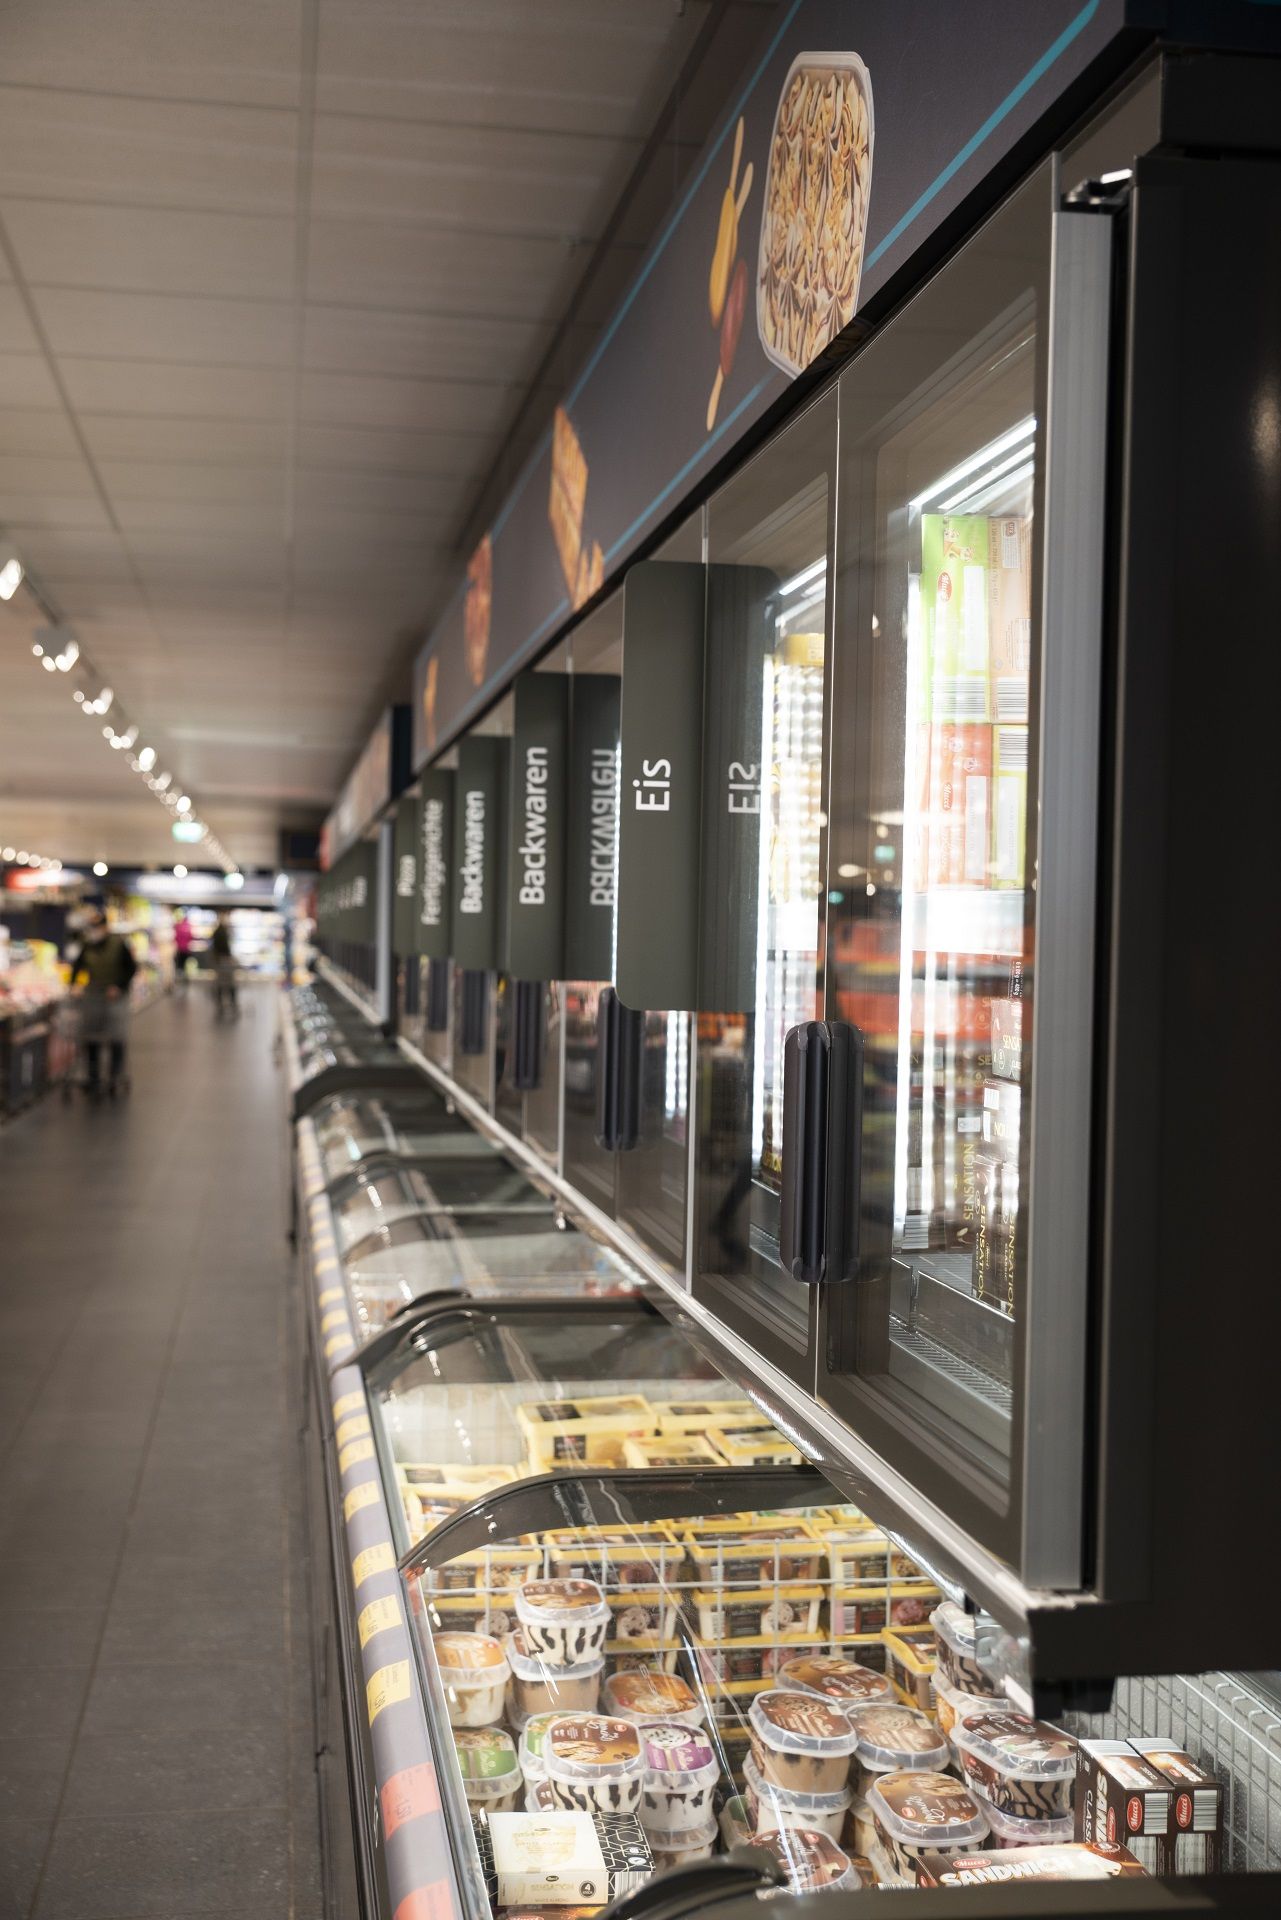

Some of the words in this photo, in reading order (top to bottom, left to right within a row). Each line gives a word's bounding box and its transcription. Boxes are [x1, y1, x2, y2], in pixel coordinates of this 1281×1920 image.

[632, 758, 671, 811] Eis
[459, 790, 485, 913] Backwaren
[518, 746, 548, 905] Backwaren
[963, 1143, 976, 1221] SENSATION
[977, 1204, 987, 1301] SENSATION
[1131, 1801, 1139, 1827] Mucci
[1180, 1797, 1189, 1824] Mucci
[584, 1883, 591, 1891] 4
[956, 1859, 987, 1867] Mucci
